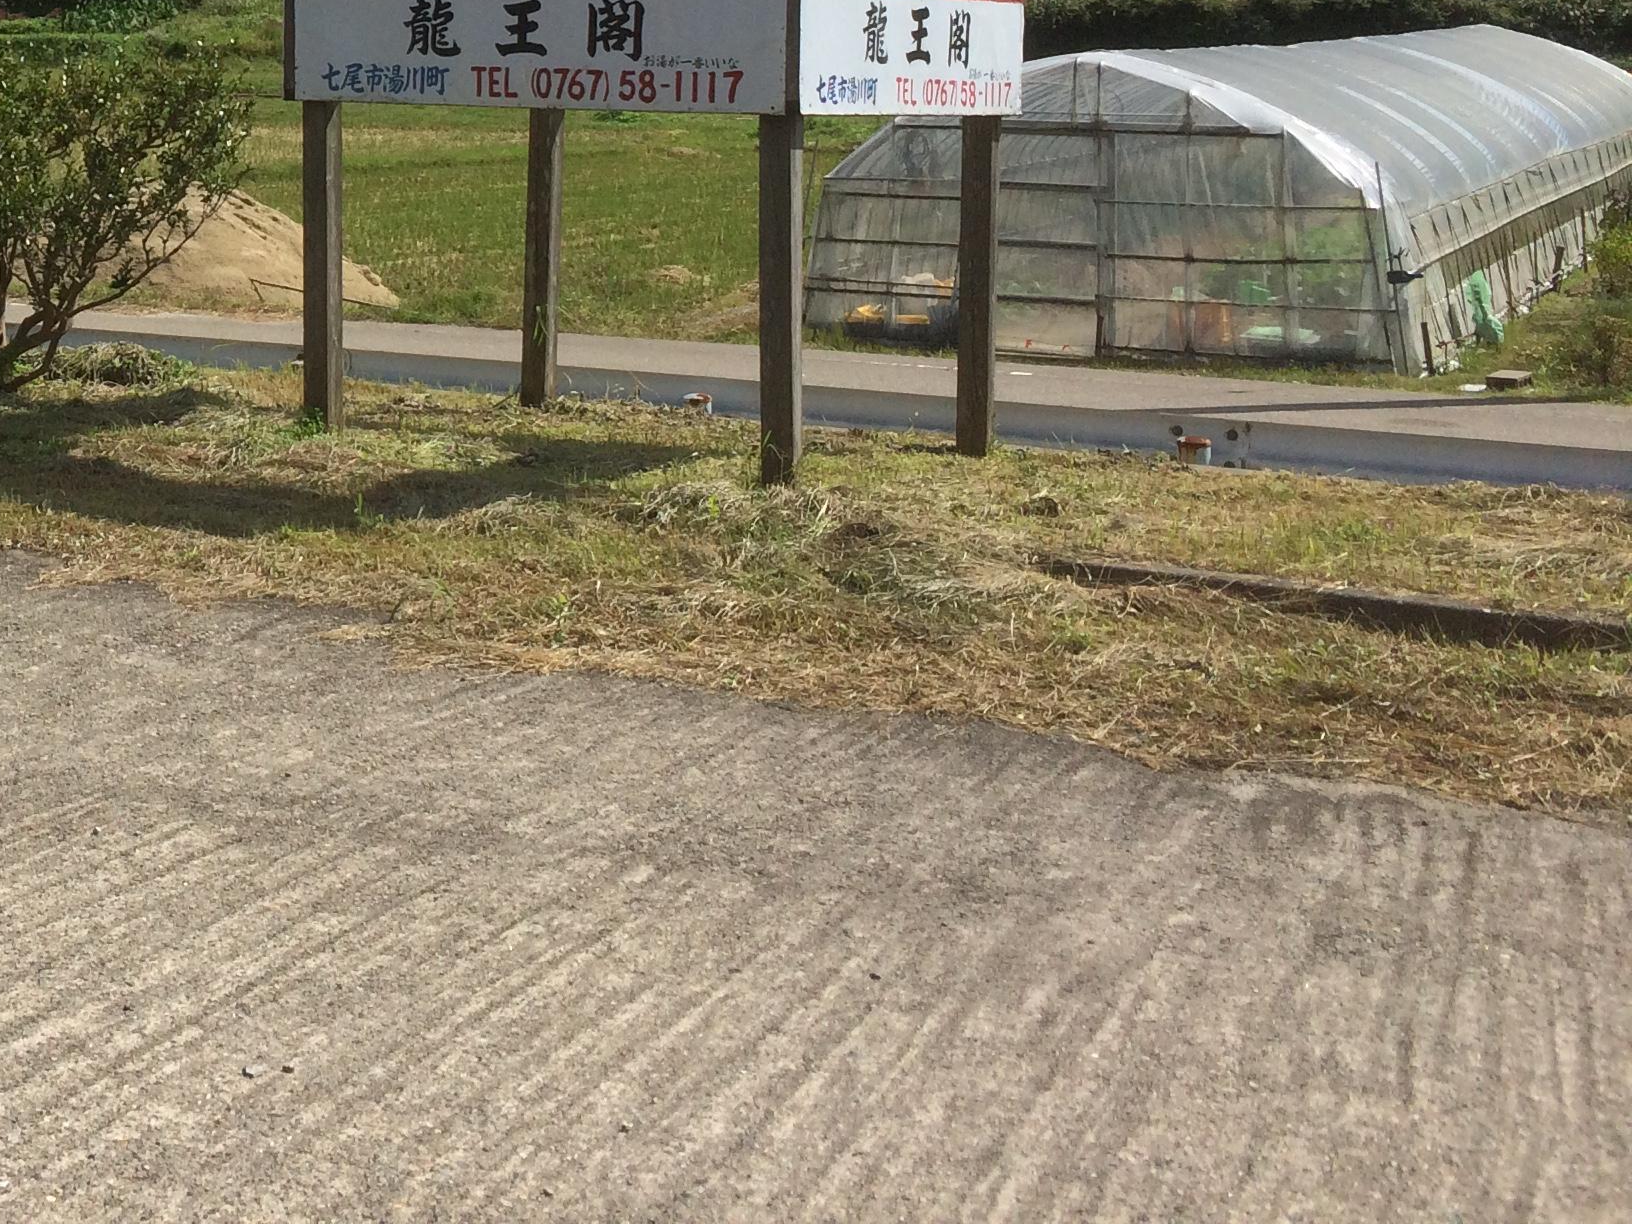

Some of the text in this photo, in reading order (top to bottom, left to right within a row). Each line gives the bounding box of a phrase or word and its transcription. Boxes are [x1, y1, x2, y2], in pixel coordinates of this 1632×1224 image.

[321, 62, 451, 96] 七尾市湯川町
[470, 65, 519, 98] TEL
[815, 74, 879, 107] 七尾市湯川町
[895, 77, 918, 107] TEL
